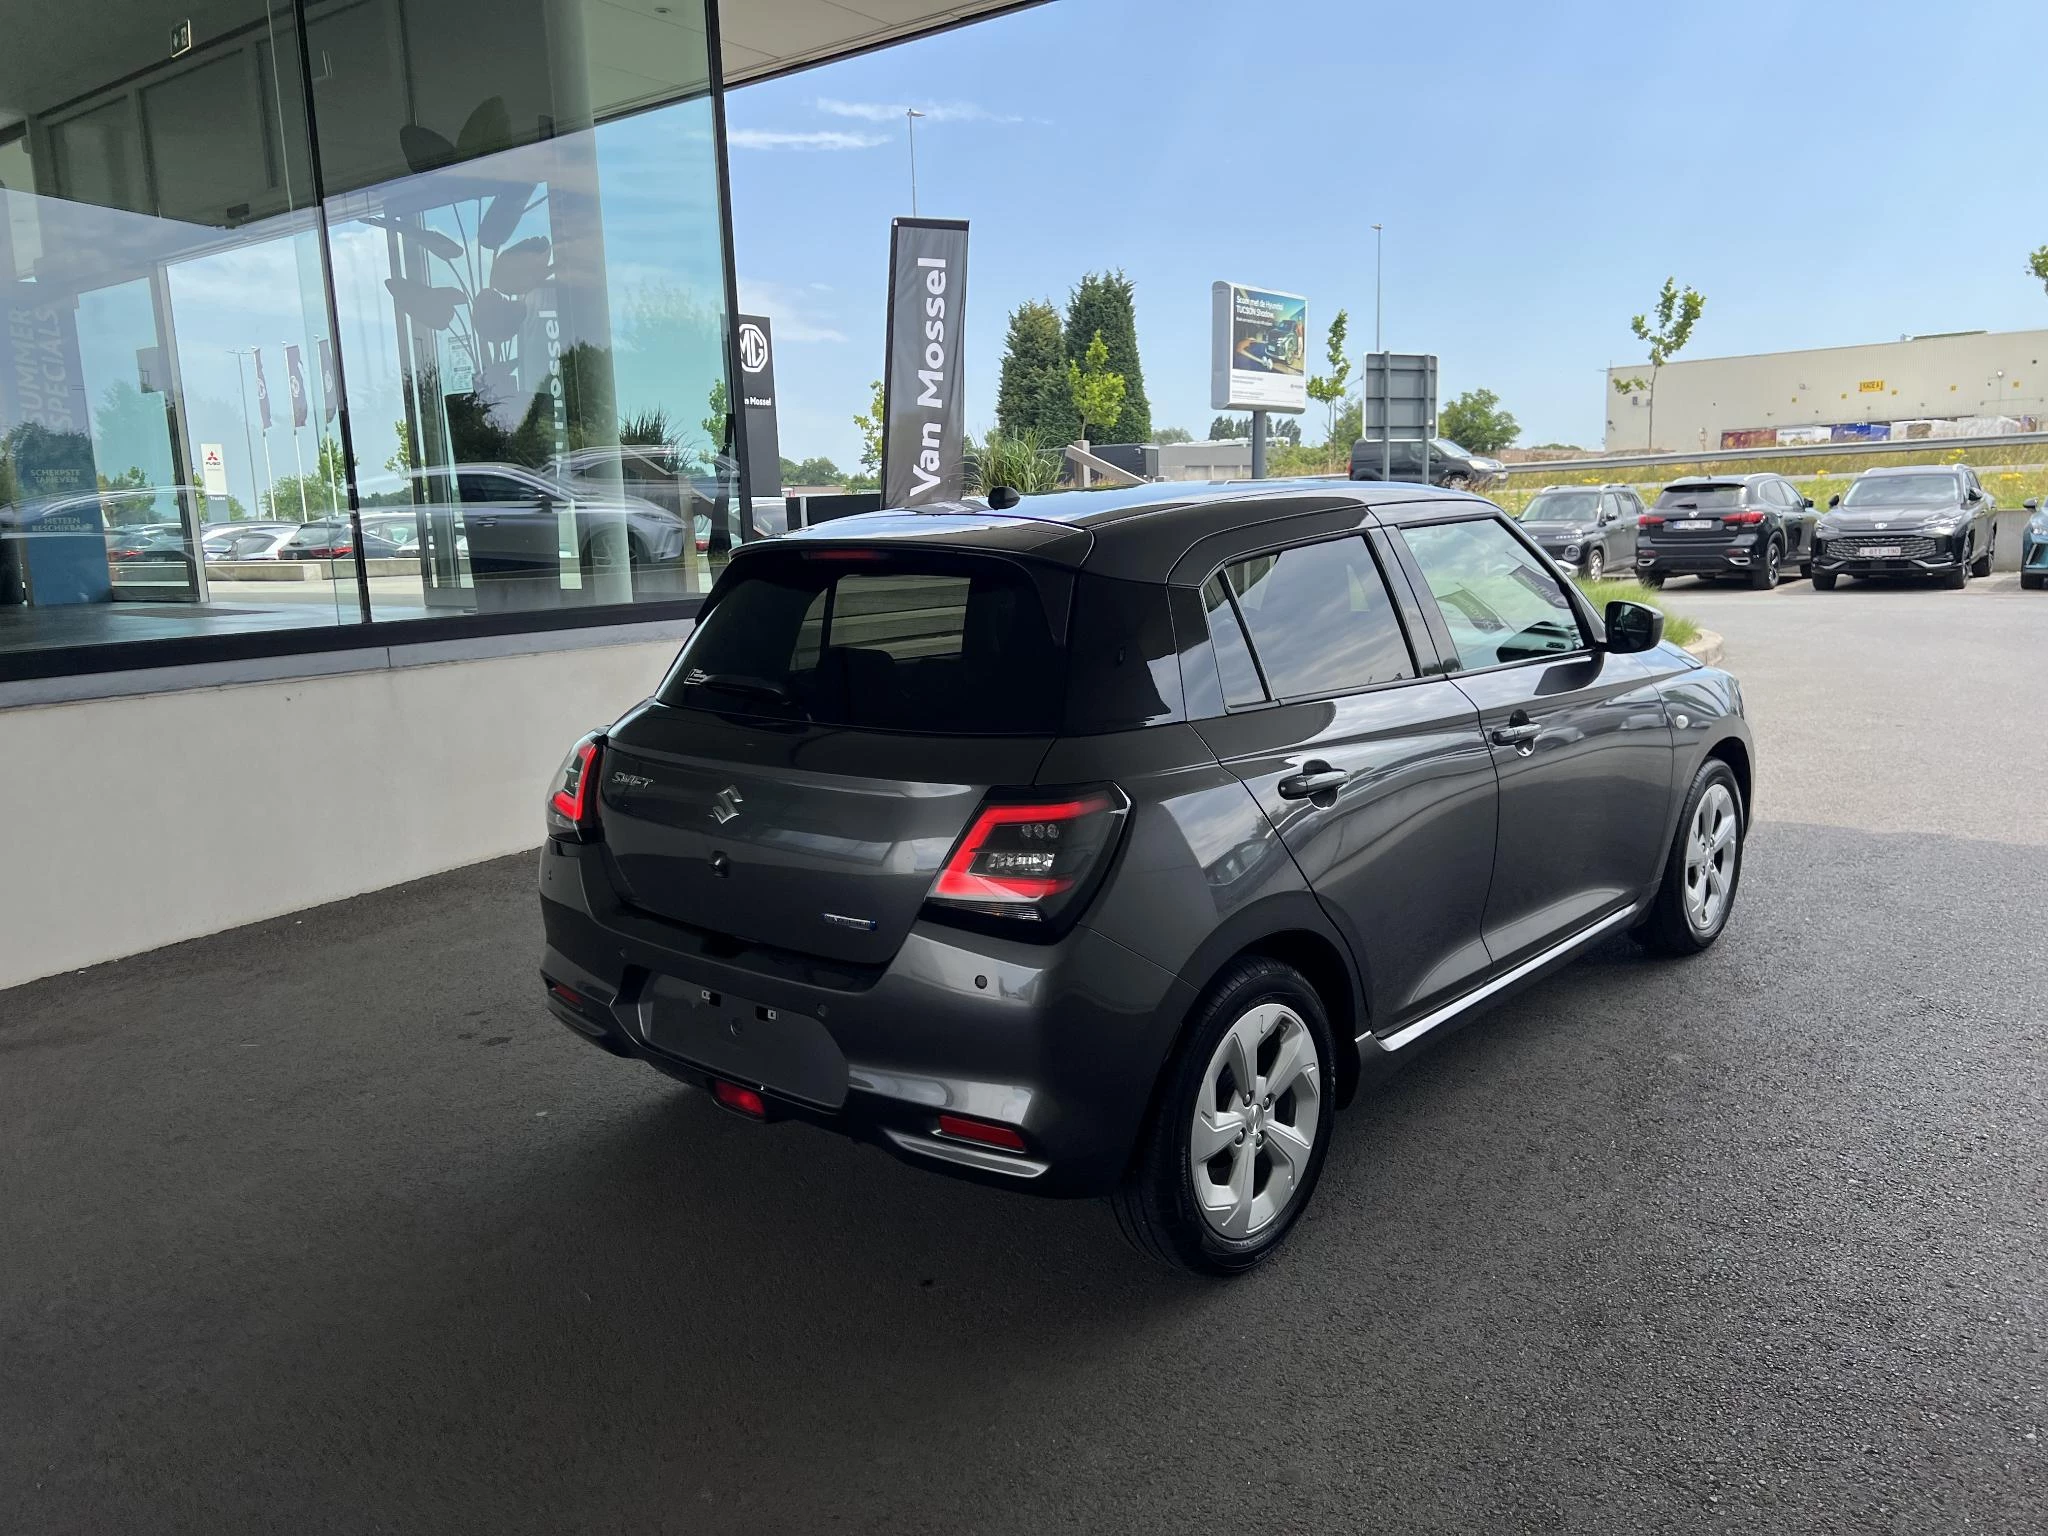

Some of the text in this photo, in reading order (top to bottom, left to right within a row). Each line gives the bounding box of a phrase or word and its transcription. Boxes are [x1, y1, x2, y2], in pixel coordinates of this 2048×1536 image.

[33, 305, 73, 431] SPECIALS
[750, 397, 772, 406] Mossel
[910, 257, 947, 496] Van Mossel
[611, 771, 654, 789] SWIFT
